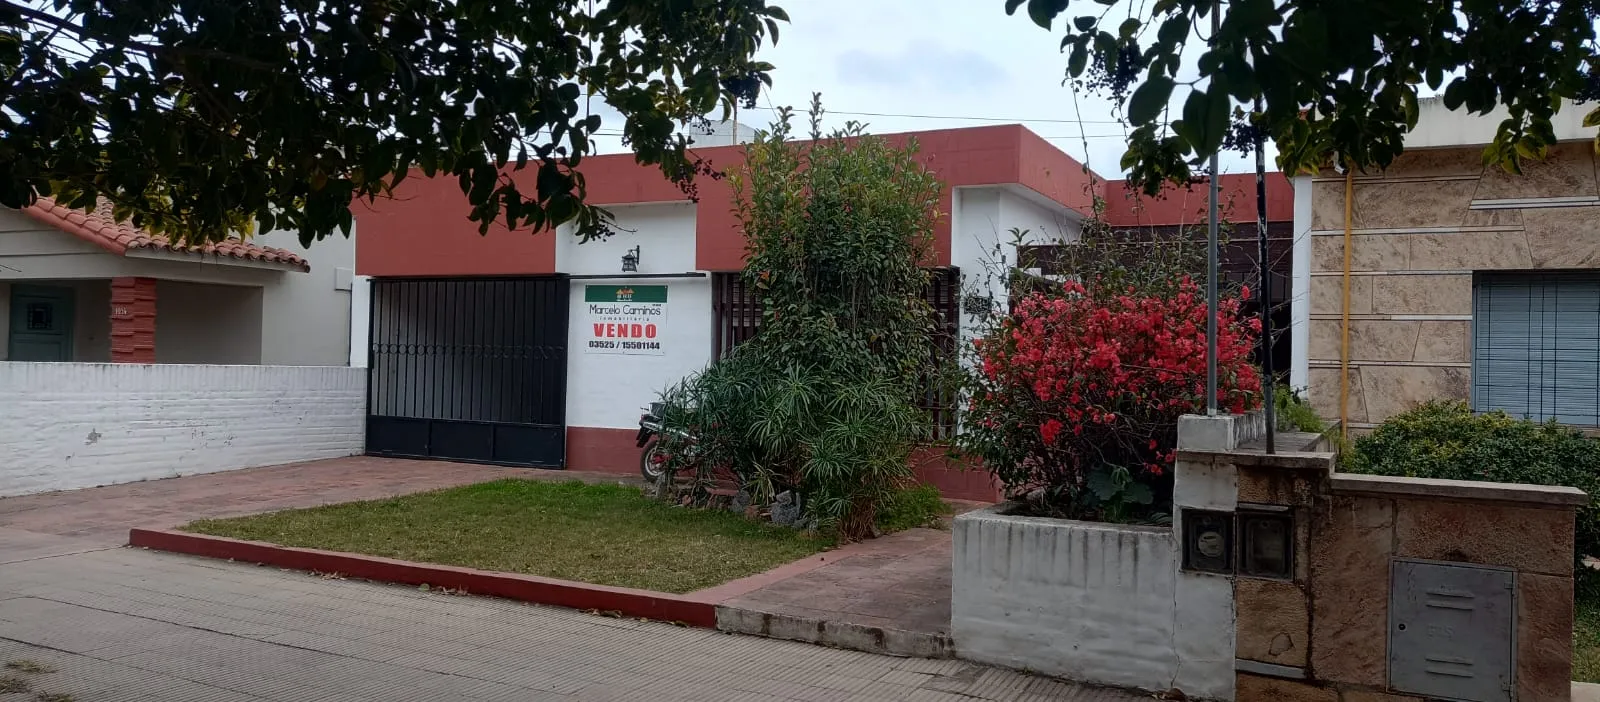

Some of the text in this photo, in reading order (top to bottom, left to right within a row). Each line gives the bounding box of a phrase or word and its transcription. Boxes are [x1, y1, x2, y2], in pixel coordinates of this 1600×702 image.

[589, 304, 620, 315] Marcelo
[622, 304, 661, 316] Caminos
[593, 323, 657, 338] VENDO
[589, 340, 615, 349] 03525
